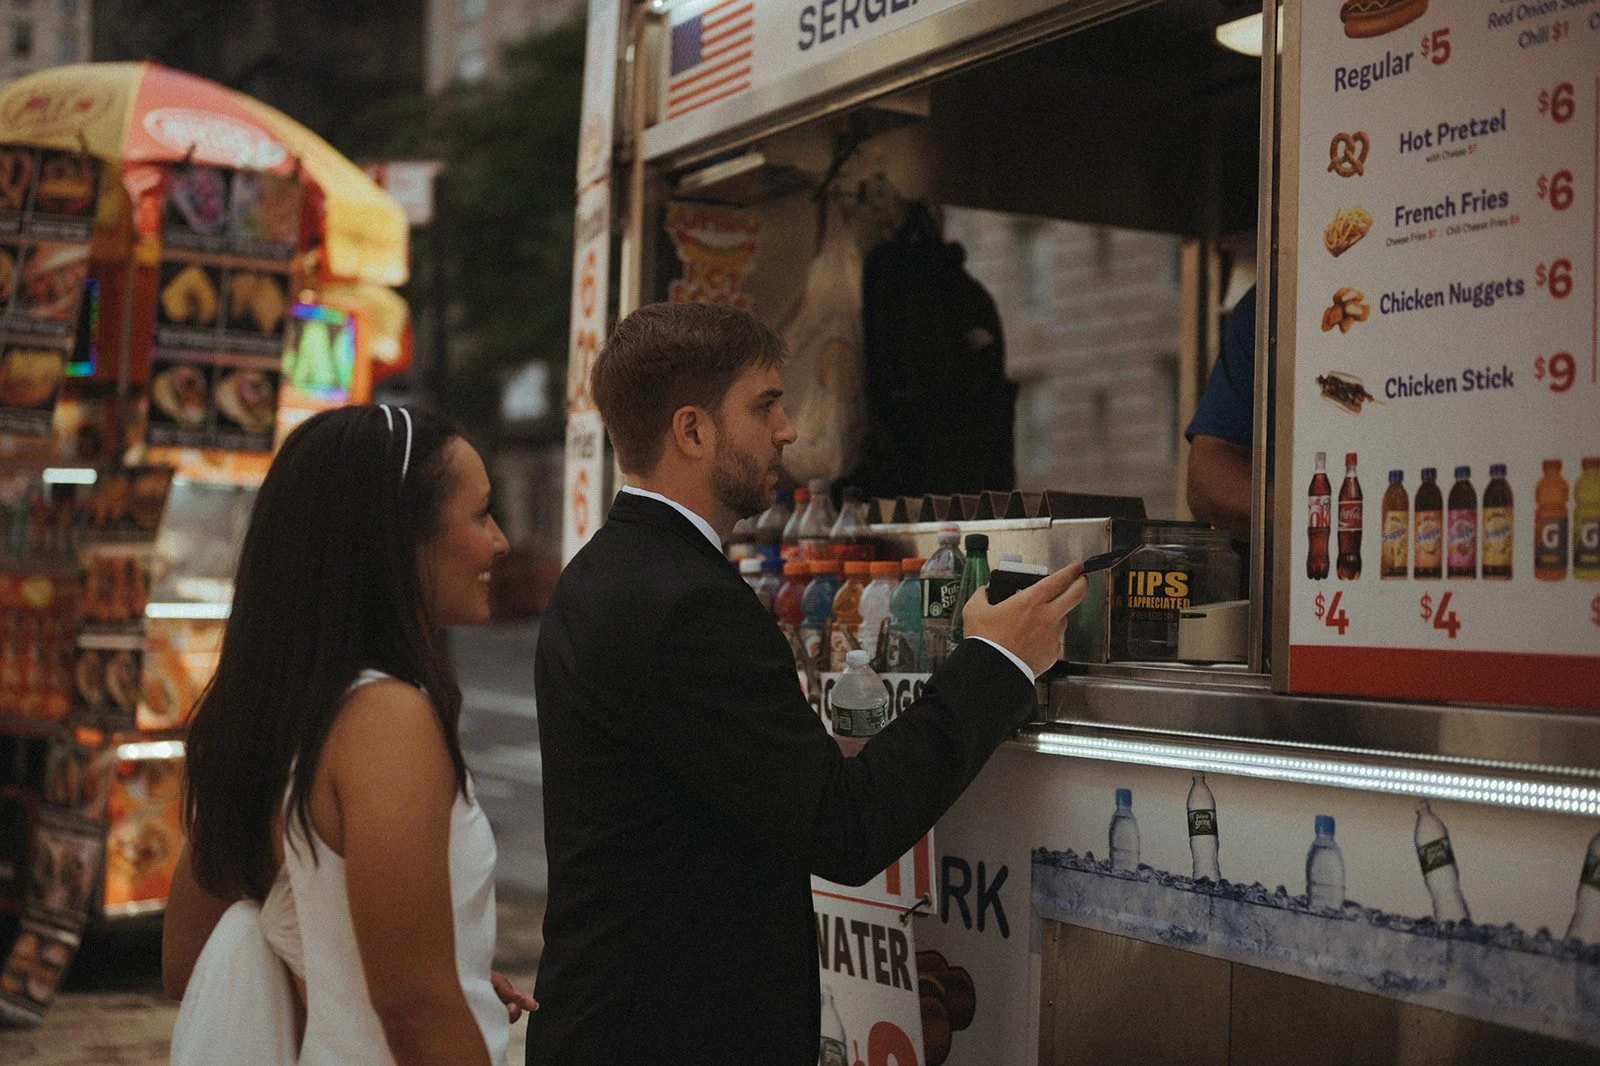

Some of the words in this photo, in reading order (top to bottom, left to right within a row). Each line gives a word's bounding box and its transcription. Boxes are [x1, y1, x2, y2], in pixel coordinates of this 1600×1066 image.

[1335, 51, 1414, 92] Regular
[1421, 27, 1451, 65] $5
[1400, 130, 1432, 154] Hot
[1438, 108, 1507, 145] Pretzel
[1538, 82, 1576, 124] $6
[1395, 195, 1456, 227] French
[1461, 188, 1509, 214] Fries
[1536, 169, 1575, 211] $6
[1380, 287, 1444, 315] Chicken
[1449, 277, 1525, 308] Nuggets
[1535, 257, 1573, 299] $6
[1385, 371, 1457, 400] Chicken
[1462, 364, 1514, 394] Stick
[1534, 352, 1576, 393] $9
[1128, 571, 1189, 597] TIPS
[1314, 591, 1349, 635] $4
[1420, 591, 1461, 639] $4
[941, 856, 1010, 940] RK
